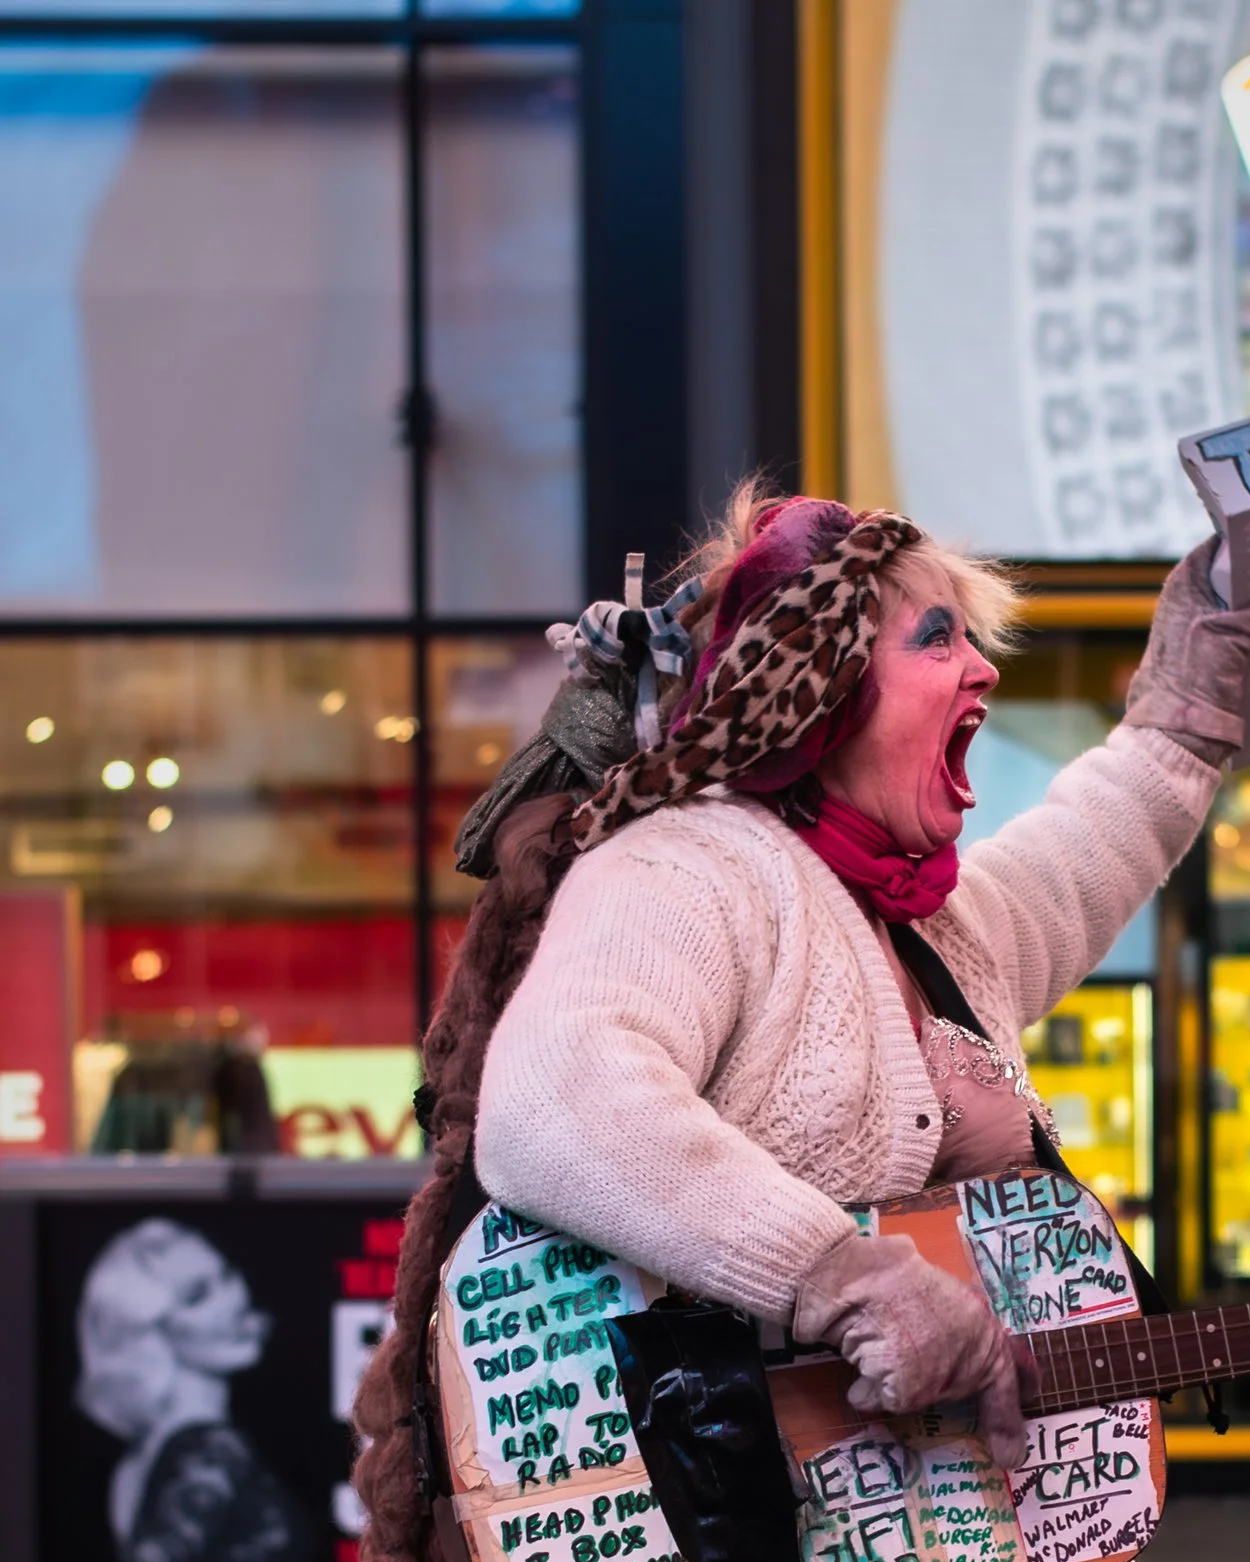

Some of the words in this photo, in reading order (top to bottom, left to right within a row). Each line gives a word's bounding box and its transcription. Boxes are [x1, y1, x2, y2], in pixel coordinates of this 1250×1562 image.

[964, 1173, 1083, 1227] NEED
[457, 1262, 535, 1311] CELL
[1082, 1266, 1126, 1294] CARD
[473, 1345, 538, 1381] DVD
[487, 1378, 580, 1436] MEMO
[1100, 1404, 1139, 1421] TACO
[502, 1423, 559, 1462] LAP
[586, 1411, 630, 1443] TO
[1112, 1422, 1148, 1439] BELL
[1036, 1451, 1140, 1501] CARD
[501, 1508, 585, 1552] HEAD
[924, 1526, 993, 1550] BURGER
[1024, 1497, 1108, 1548] WALMART
